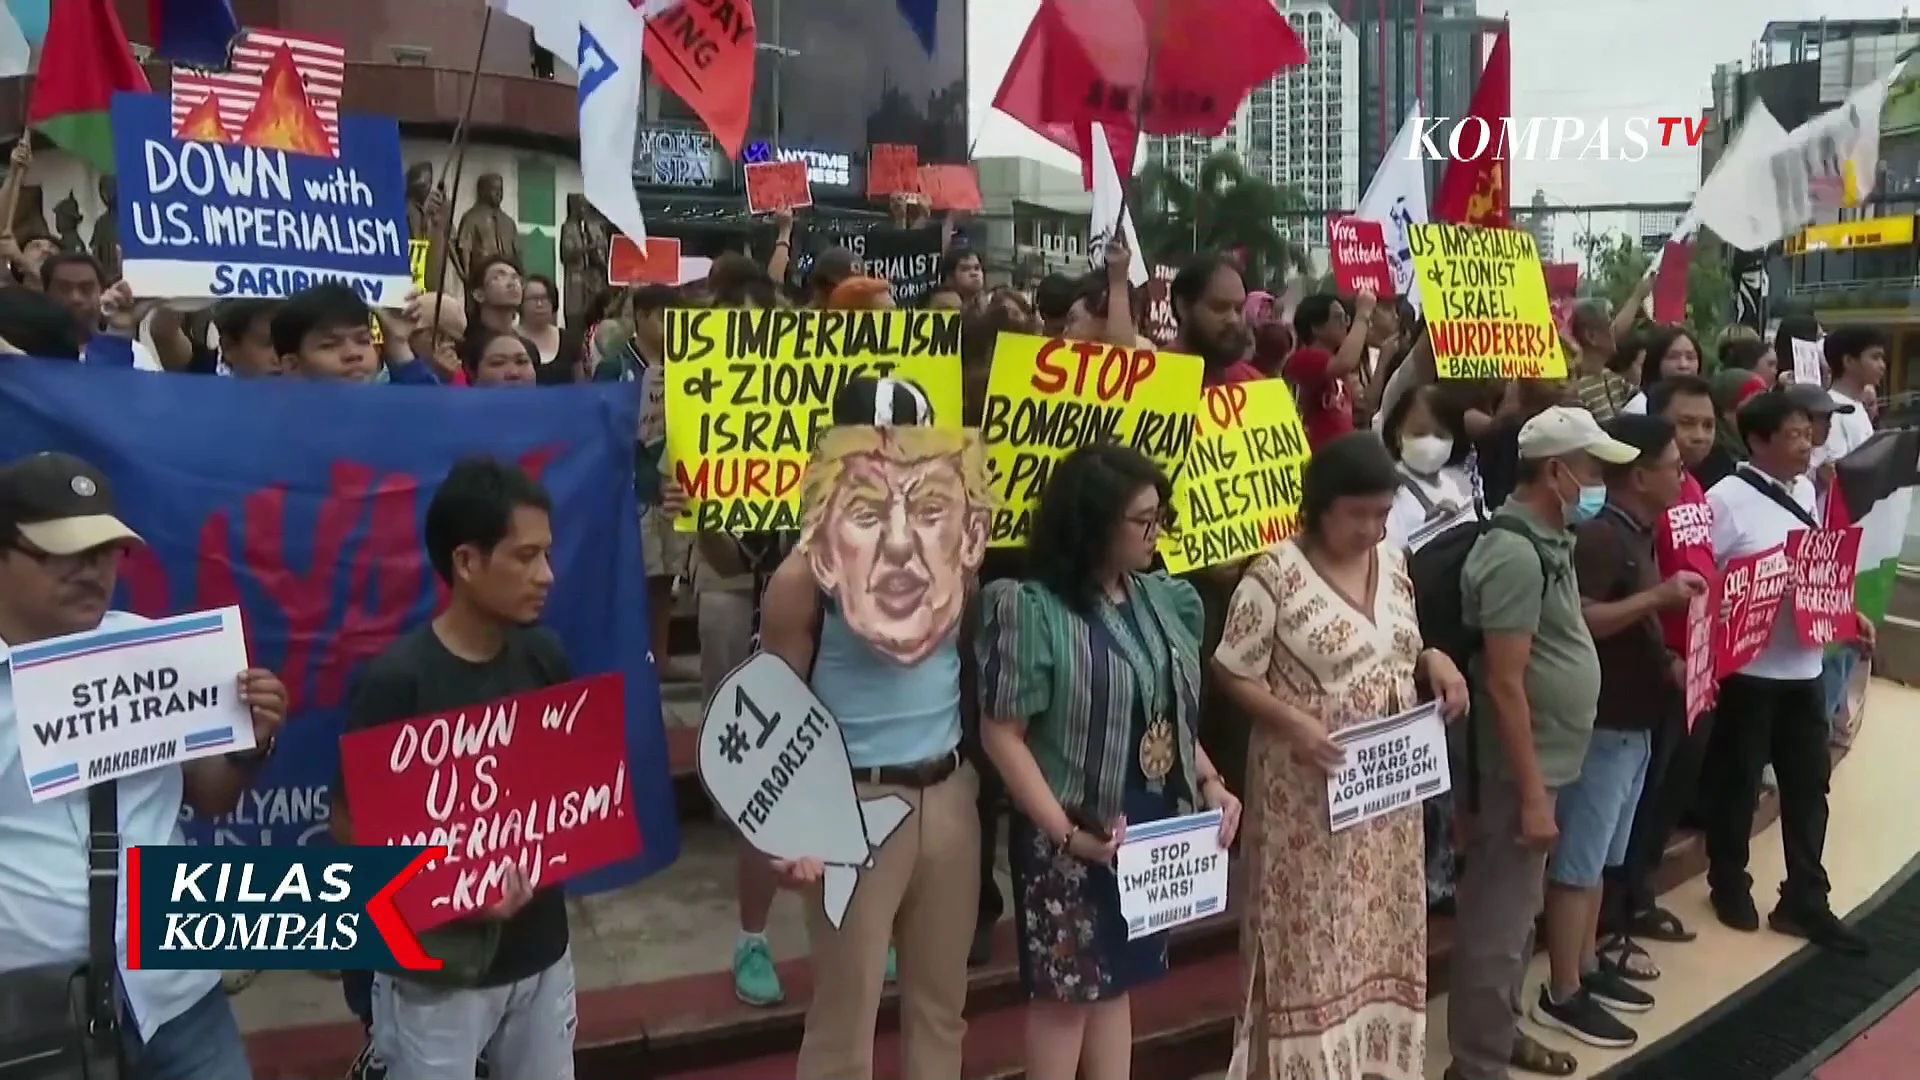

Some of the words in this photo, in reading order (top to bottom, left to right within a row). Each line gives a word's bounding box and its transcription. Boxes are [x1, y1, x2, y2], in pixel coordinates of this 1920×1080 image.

[144, 139, 292, 201] DOWN
[304, 167, 373, 208] with
[132, 201, 200, 246] U.S.
[203, 204, 401, 257] IMPERIALISM
[1407, 224, 1435, 257] US
[1438, 224, 1534, 261] IMPERIALISM
[1446, 259, 1516, 289] ZIONIST
[1442, 289, 1518, 321] ISRAEL,
[665, 310, 715, 363] US
[725, 310, 963, 360] IMPERIALISM
[1429, 319, 1555, 360] MURDERERS!
[1030, 338, 1157, 403] STOP
[1130, 408, 1196, 461] IRAN
[1242, 420, 1303, 466] IRAN
[72, 666, 179, 708] STAND
[33, 704, 119, 747] WITH
[129, 686, 218, 724] IRAN!
[390, 700, 518, 773] DOWN
[718, 685, 781, 764] #1
[88, 739, 177, 780] MAKABAYAN
[738, 705, 830, 834] TERRORIST!
[1338, 768, 1357, 786] US
[1362, 752, 1408, 777] WARS
[1412, 743, 1430, 762] OF
[1357, 735, 1411, 764] RESIST
[426, 755, 510, 822] U.S.
[1333, 755, 1438, 804] AGGRESSION!
[1123, 854, 1218, 892] IMPERIALIST
[1151, 841, 1191, 865] STOP
[1146, 878, 1194, 904] WARS!
